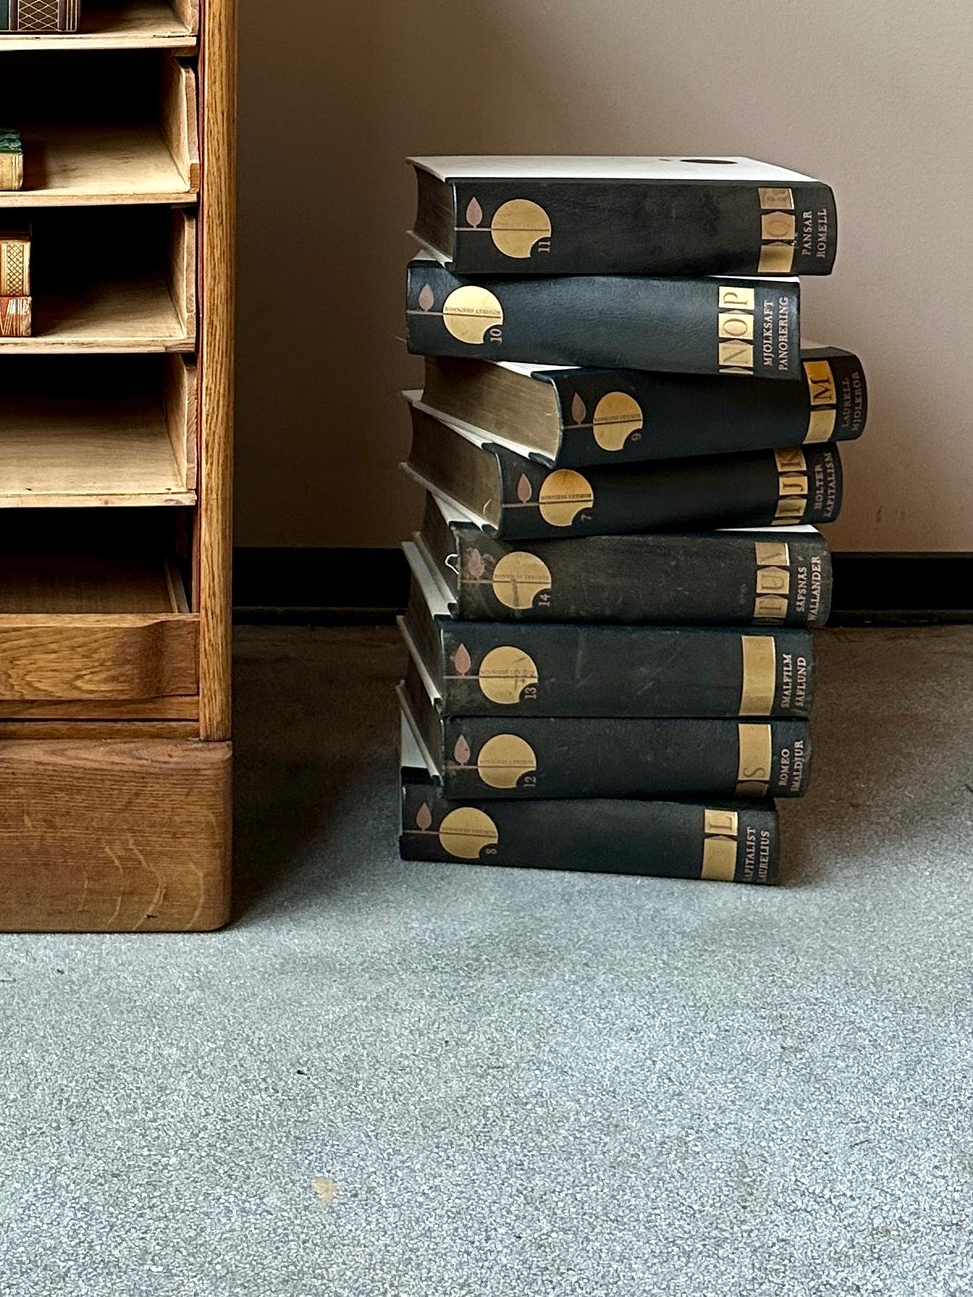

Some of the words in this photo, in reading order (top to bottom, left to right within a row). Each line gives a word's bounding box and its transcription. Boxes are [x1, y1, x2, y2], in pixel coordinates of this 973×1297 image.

[801, 210, 813, 256] PANSAR
[815, 208, 827, 258] ROMELL
[538, 240, 551, 253] 11
[723, 291, 748, 305] P
[490, 328, 502, 344] 10
[723, 318, 748, 337] O
[778, 296, 789, 371] PANORERING
[723, 346, 748, 364] N
[811, 377, 833, 402] M
[841, 377, 852, 428] LAURELL
[782, 482, 804, 492] J
[813, 464, 824, 510] HOLTER
[822, 451, 835, 518] KAPITALISM
[807, 555, 821, 622] WALLANDER
[538, 593, 551, 607] 14
[780, 653, 793, 708] SMALFILM
[524, 686, 537, 700] 13
[743, 767, 766, 778] S
[778, 748, 790, 786] ROMEO
[790, 739, 805, 792] SMALDJUR
[523, 776, 537, 787] 12
[709, 816, 733, 831] L
